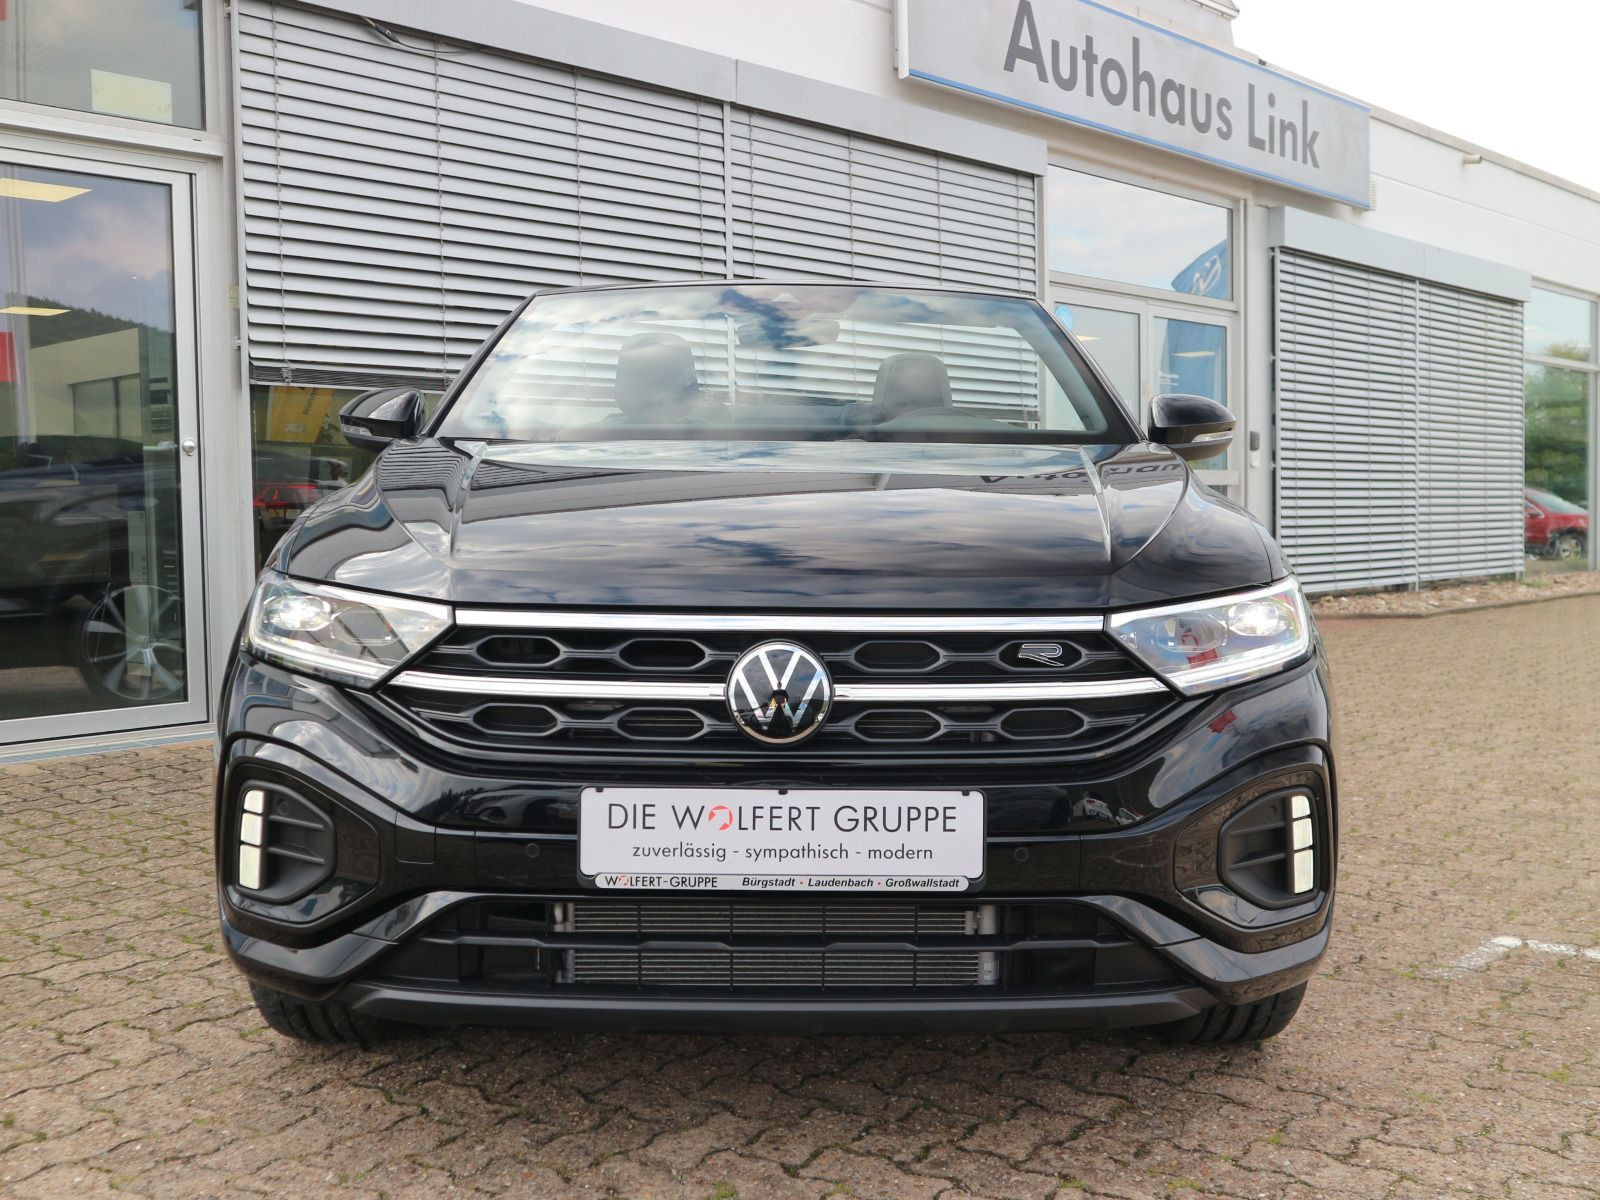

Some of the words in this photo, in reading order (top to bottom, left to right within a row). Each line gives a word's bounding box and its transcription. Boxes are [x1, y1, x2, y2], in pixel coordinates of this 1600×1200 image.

[1003, 0, 1233, 141] Autohaus
[1248, 83, 1320, 169] Link
[608, 803, 656, 830] DIE
[833, 805, 957, 833] GRUPPE
[632, 841, 726, 863] zuverlässig
[745, 842, 849, 864] sympathisch
[868, 843, 934, 860] modern
[741, 877, 796, 888] Bürgstadt
[807, 878, 874, 888] Laudenbach
[885, 878, 960, 888] Großwallstadt
